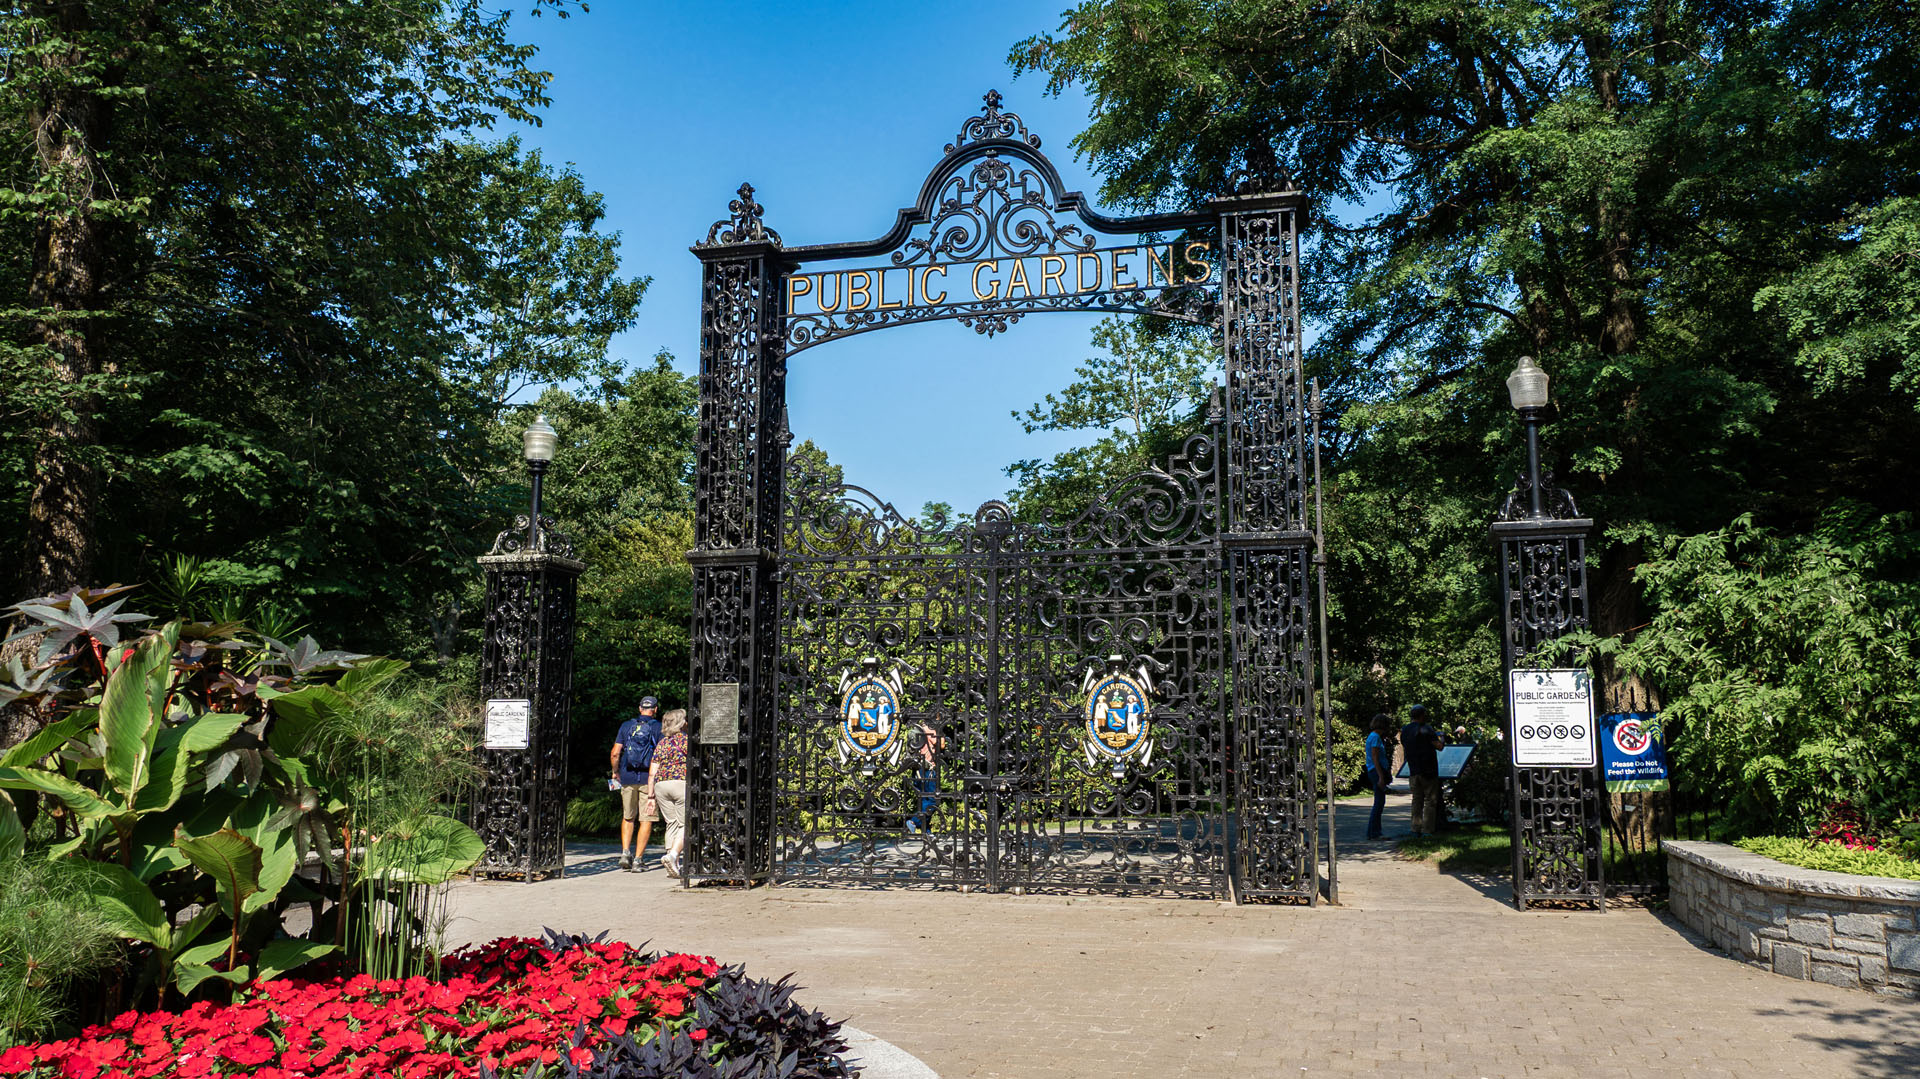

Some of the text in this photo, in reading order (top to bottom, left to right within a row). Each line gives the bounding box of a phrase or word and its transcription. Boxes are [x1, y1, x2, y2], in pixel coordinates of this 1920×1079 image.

[787, 242, 1212, 315] PUBLIC GARDENS
[857, 684, 883, 695] PUBLIC
[1101, 682, 1133, 695] GARDENS
[1516, 692, 1586, 700] PUBLIC GARDENS
